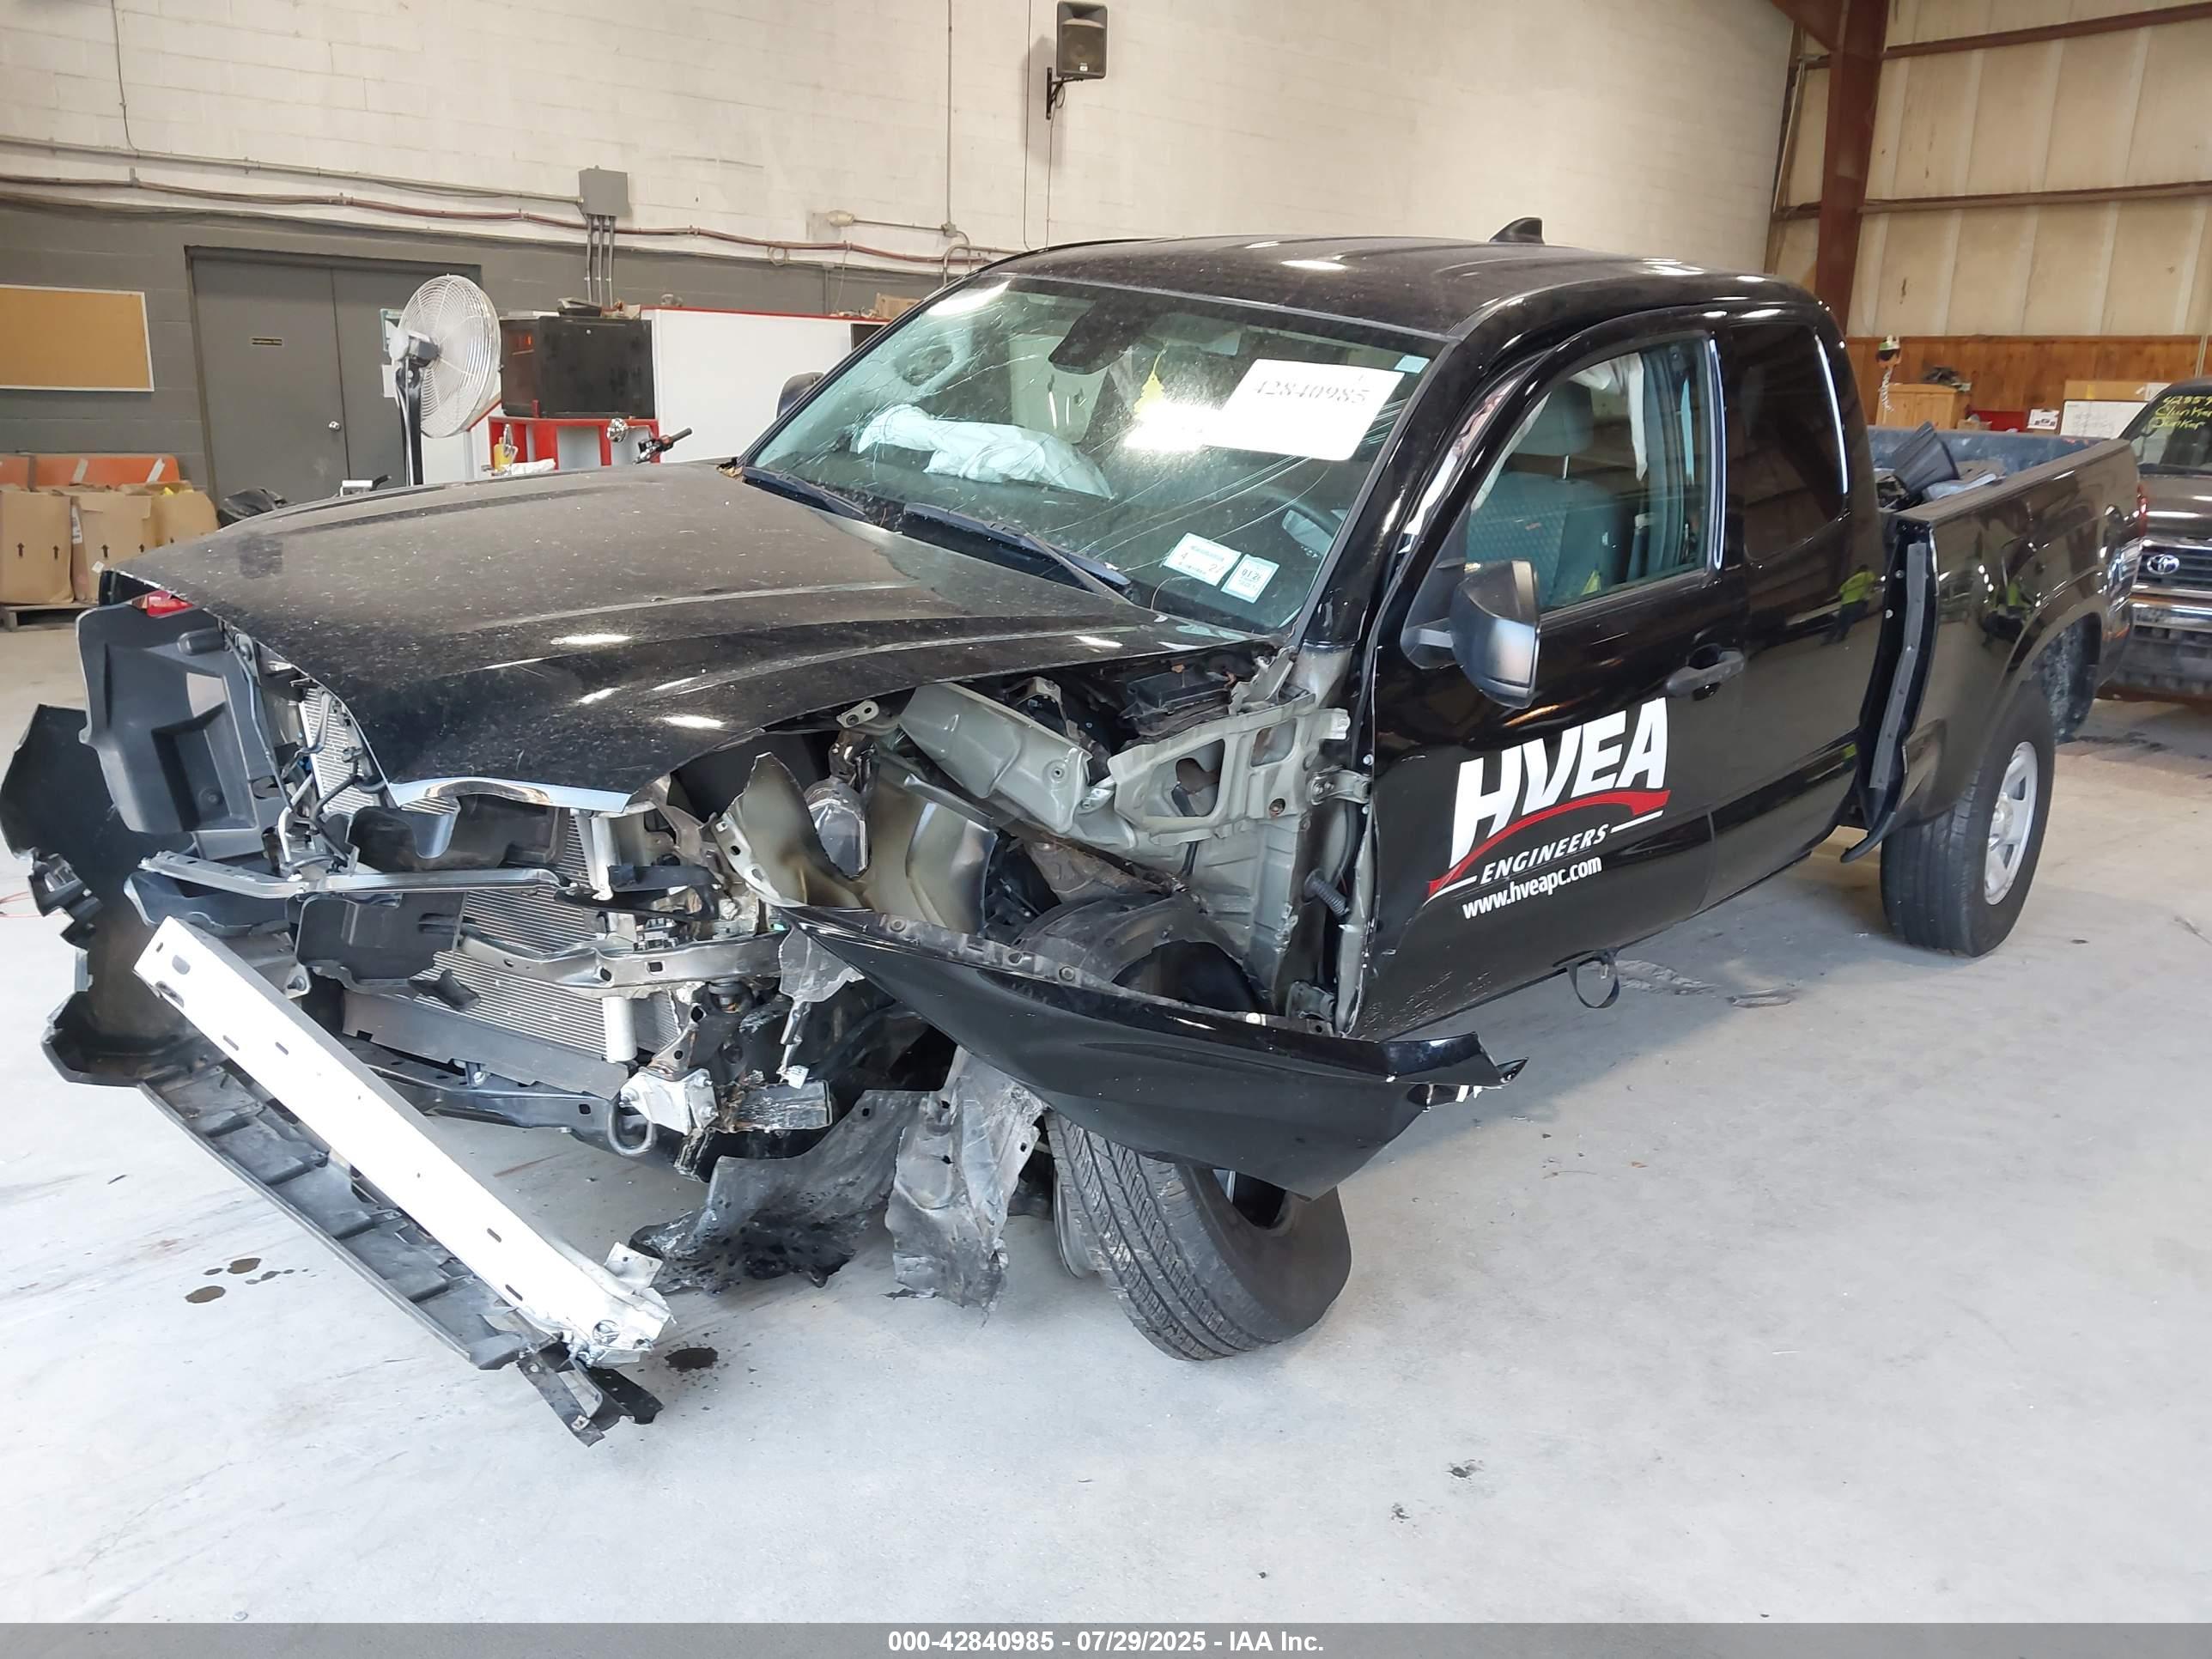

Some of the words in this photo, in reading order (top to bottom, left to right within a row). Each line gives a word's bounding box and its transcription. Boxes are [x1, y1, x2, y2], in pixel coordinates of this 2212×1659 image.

[1449, 696, 1668, 870] HVEA
[1480, 823, 1609, 884] ENGINEERS
[1462, 856, 1603, 920] www.hveapc.com
